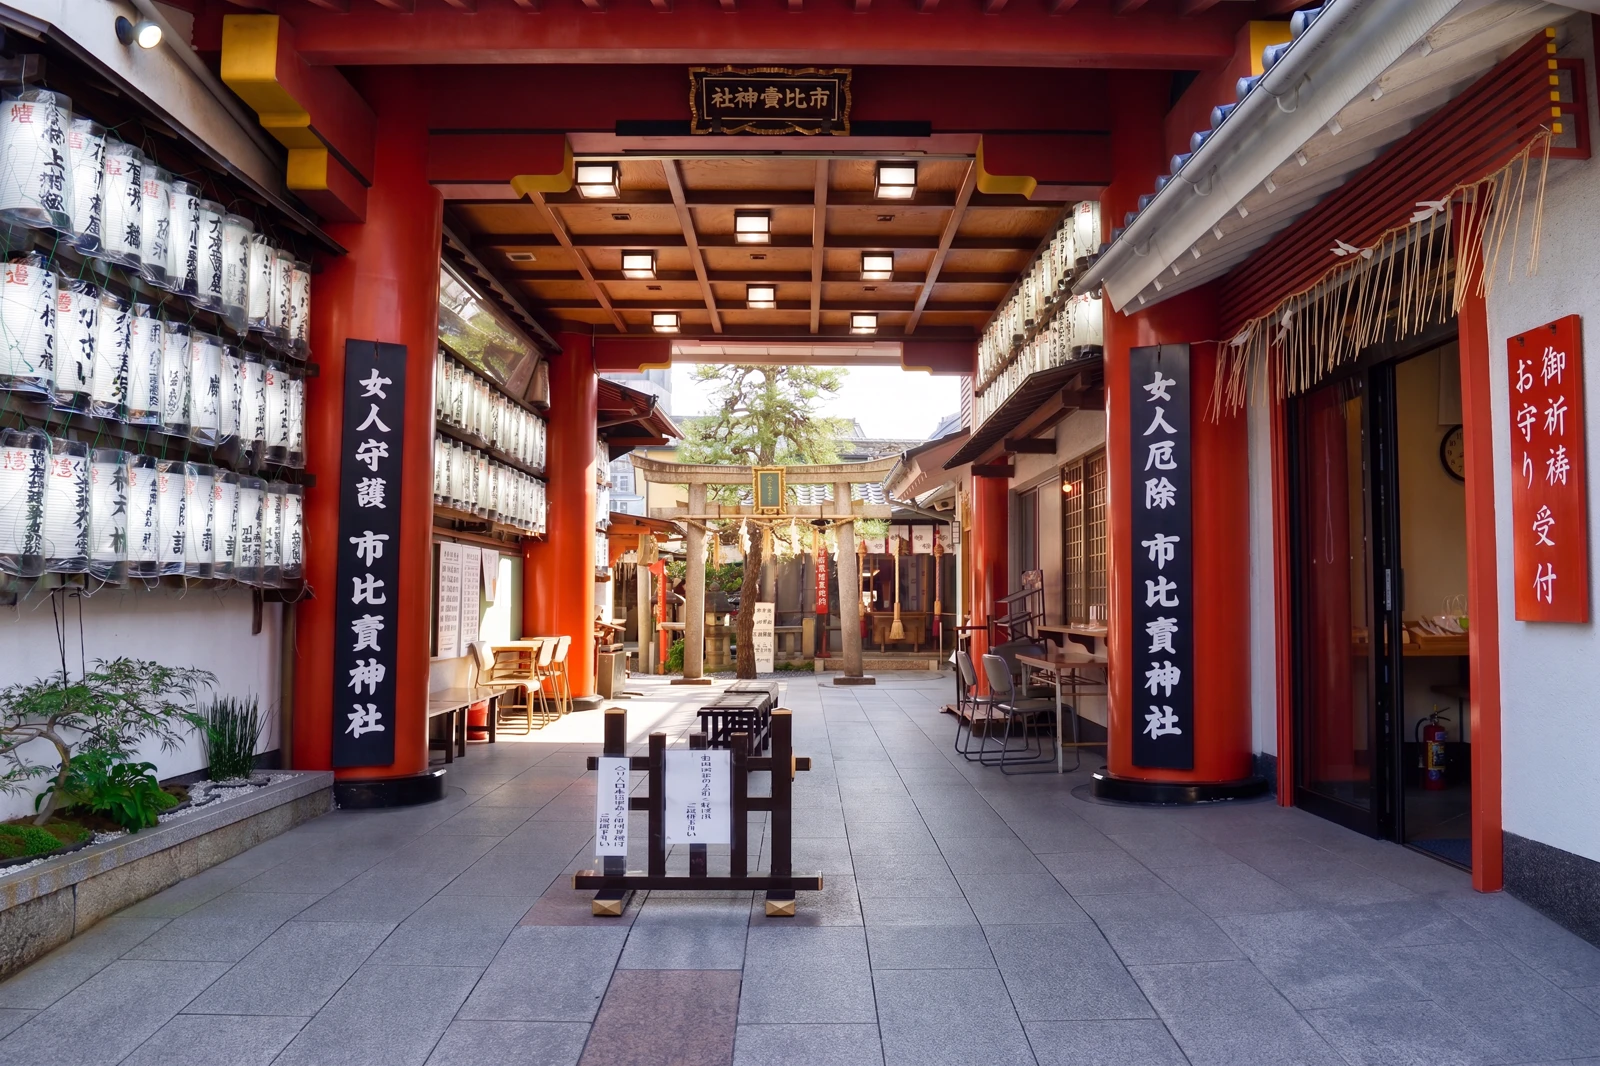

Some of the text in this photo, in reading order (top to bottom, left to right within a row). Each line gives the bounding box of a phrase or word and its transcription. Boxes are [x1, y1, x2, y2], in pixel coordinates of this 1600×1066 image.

[355, 368, 392, 509] 女人守護
[1142, 371, 1178, 509] 女人厄除
[1515, 359, 1538, 489] お守り
[1540, 346, 1570, 487] 御祈祷
[1532, 505, 1557, 604] 受付
